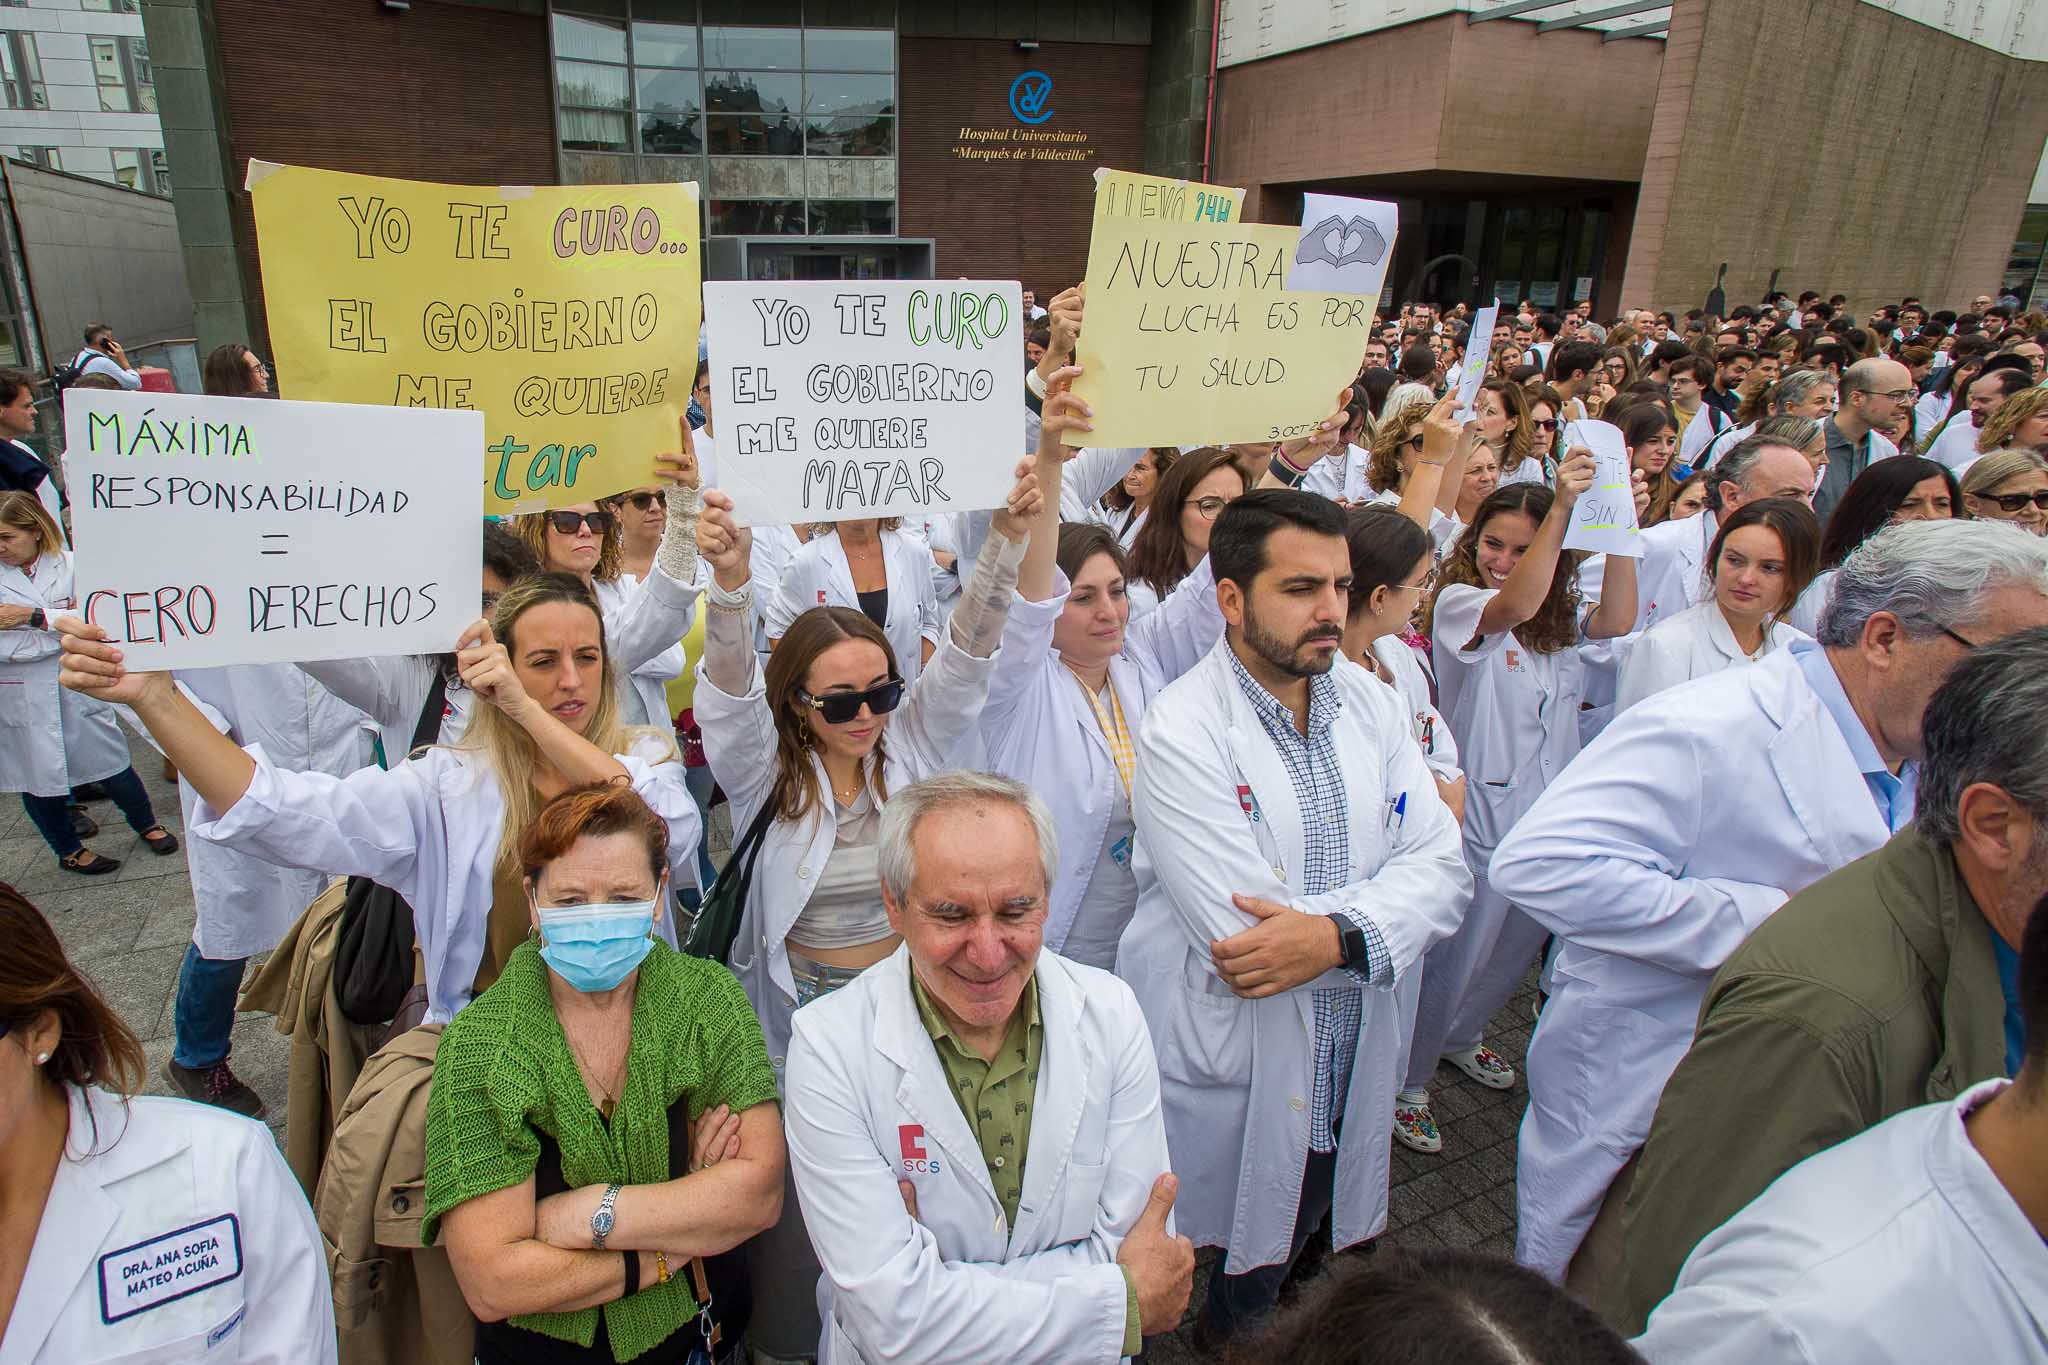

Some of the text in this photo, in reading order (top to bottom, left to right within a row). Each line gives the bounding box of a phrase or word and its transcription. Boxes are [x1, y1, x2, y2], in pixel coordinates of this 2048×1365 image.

[959, 127, 1088, 143] Hospital Universitario
[1013, 147, 1027, 160] de
[338, 196, 411, 259] YO
[448, 202, 510, 259] TE
[1106, 239, 1287, 291] NUESTRA
[328, 298, 387, 353] EL
[752, 289, 1009, 349] YO TE CURO
[1138, 297, 1365, 333] LUCHA ES POR
[394, 368, 670, 418] ME QUIERE
[732, 362, 994, 404] EL GOBIERNO
[1136, 364, 1179, 391] TU
[736, 416, 928, 455] ME QUIERE
[1268, 426, 1280, 439] 3
[484, 435, 597, 500] tar
[803, 457, 951, 510] MATAR
[1580, 499, 1618, 527] SIN
[260, 533, 290, 555] =
[84, 581, 438, 648] CERO DERECHOS
[903, 1159, 940, 1174] SCS
[122, 1237, 220, 1279] DRA. ANA SOFIA
[127, 1254, 219, 1297] MATEO ACUÑA
